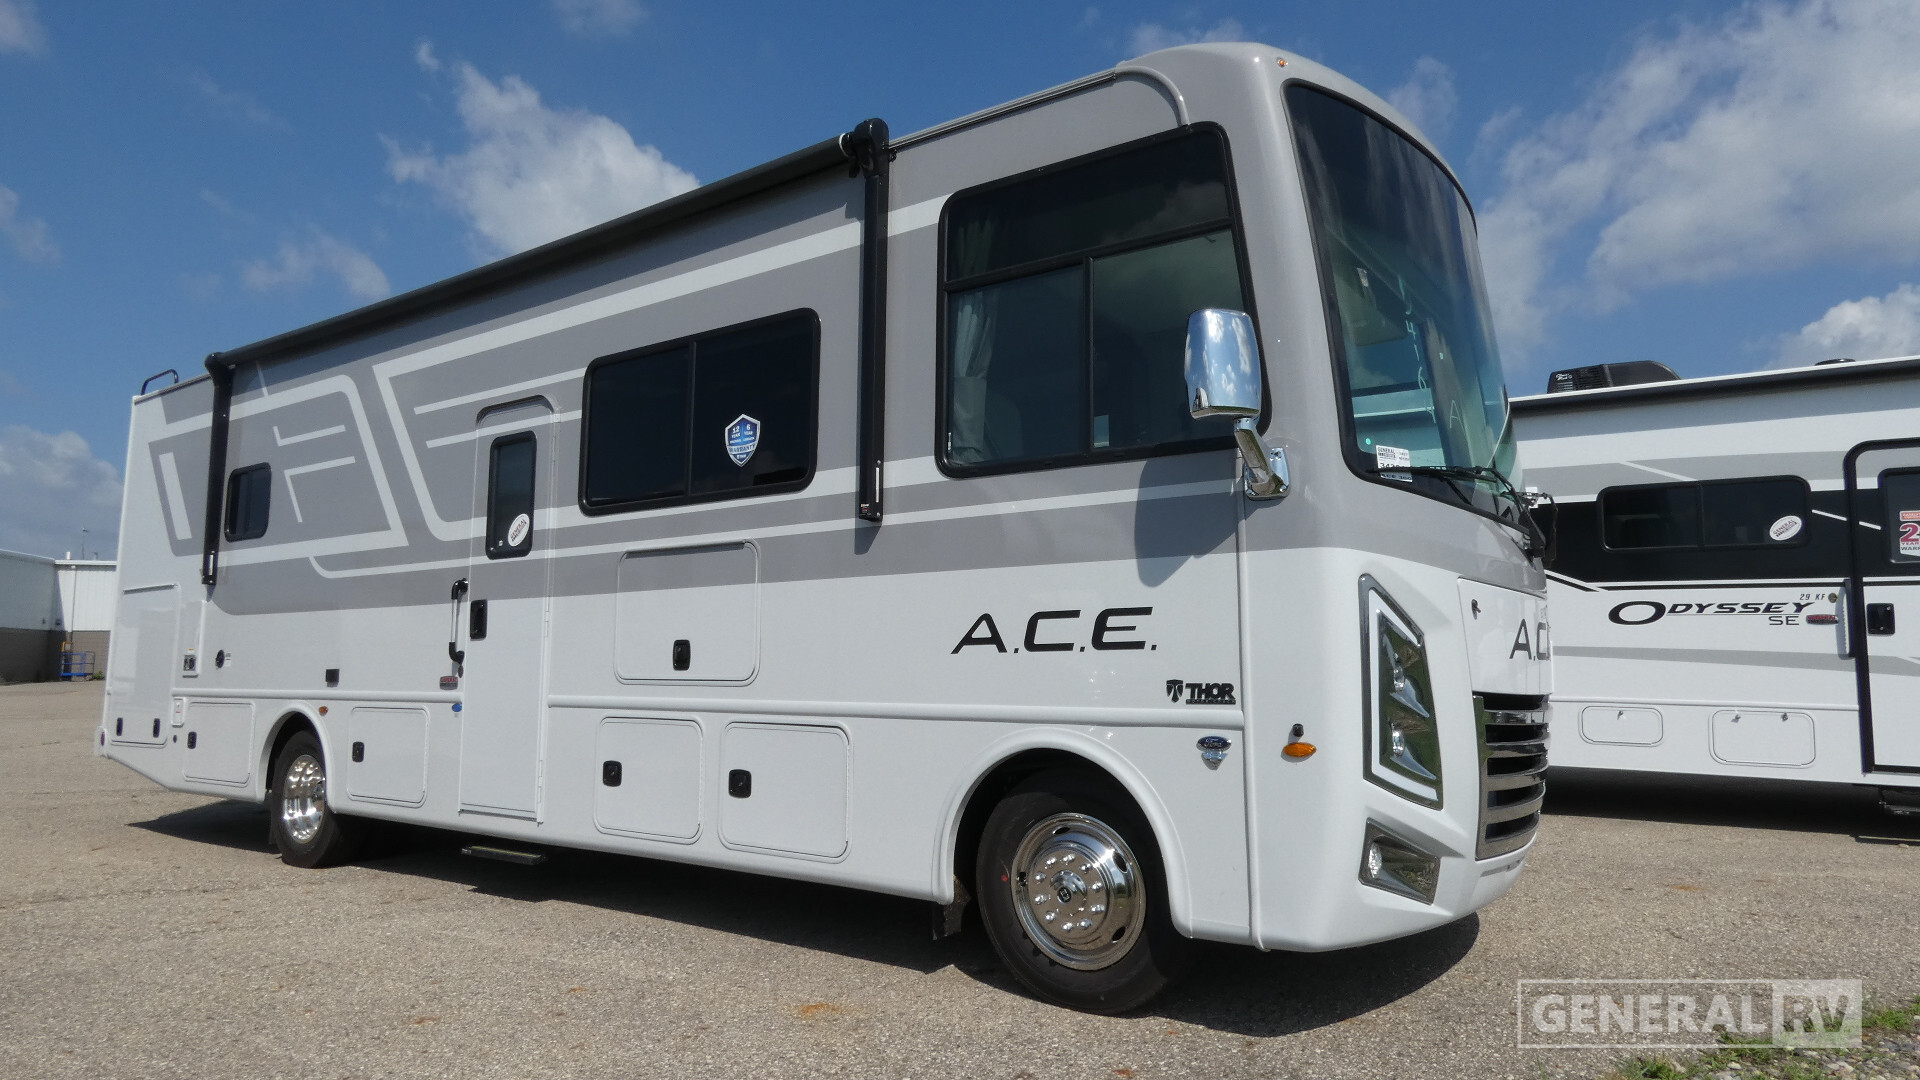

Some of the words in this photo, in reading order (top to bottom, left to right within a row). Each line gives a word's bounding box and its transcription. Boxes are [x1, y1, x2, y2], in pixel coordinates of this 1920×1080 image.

[1799, 593, 1811, 601] 29
[1815, 593, 1826, 601] KF
[1608, 600, 1815, 626] ODYSSEY
[1768, 615, 1800, 626] SE
[950, 606, 1158, 655] A.C.E.
[1185, 682, 1236, 700] THOR
